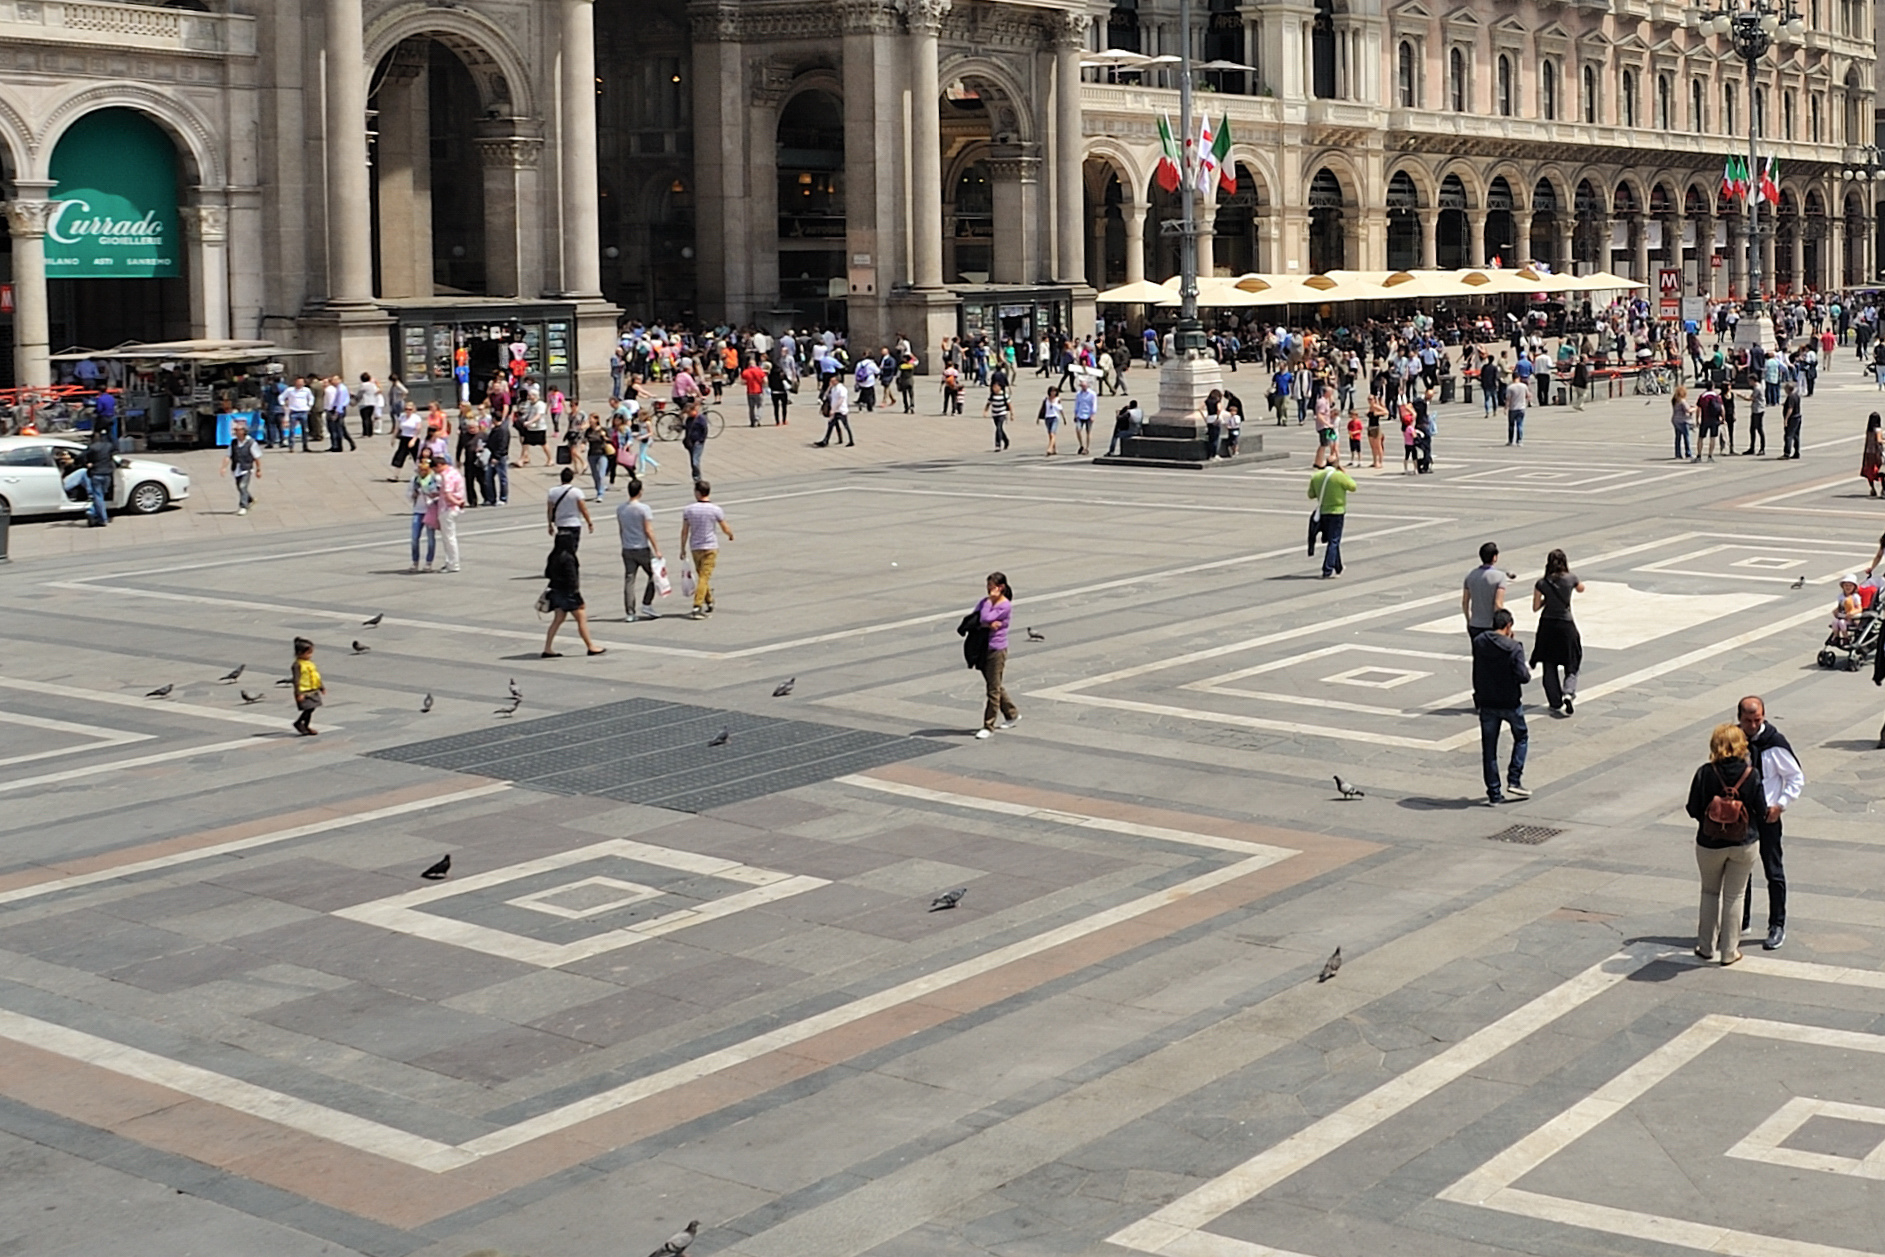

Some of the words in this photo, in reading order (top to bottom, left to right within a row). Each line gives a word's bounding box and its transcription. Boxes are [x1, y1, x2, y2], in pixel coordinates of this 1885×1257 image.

[47, 199, 163, 244] Currado
[98, 236, 163, 245] GIOIELLERIE
[93, 257, 114, 266] ASTI
[126, 257, 172, 266] SANREMO
[1712, 257, 1721, 266] M
[1661, 273, 1678, 288] M
[1, 290, 13, 307] M
